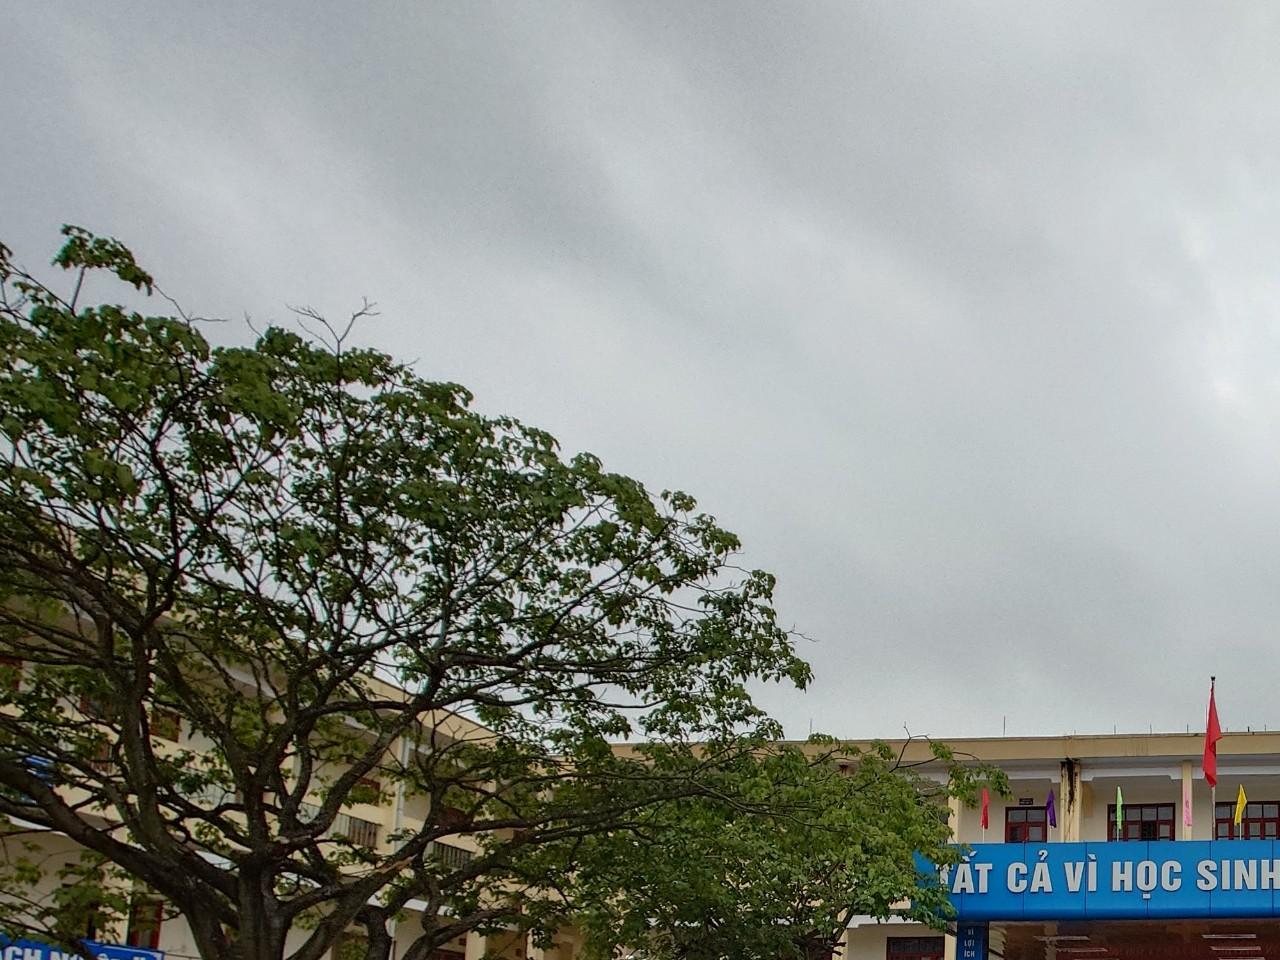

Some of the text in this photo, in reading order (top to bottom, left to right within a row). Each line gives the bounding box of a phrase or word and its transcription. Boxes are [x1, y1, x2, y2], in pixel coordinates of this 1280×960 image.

[1007, 850, 1053, 893] CẢ
[1064, 853, 1097, 893] VÌ
[1112, 860, 1182, 899] HỌC
